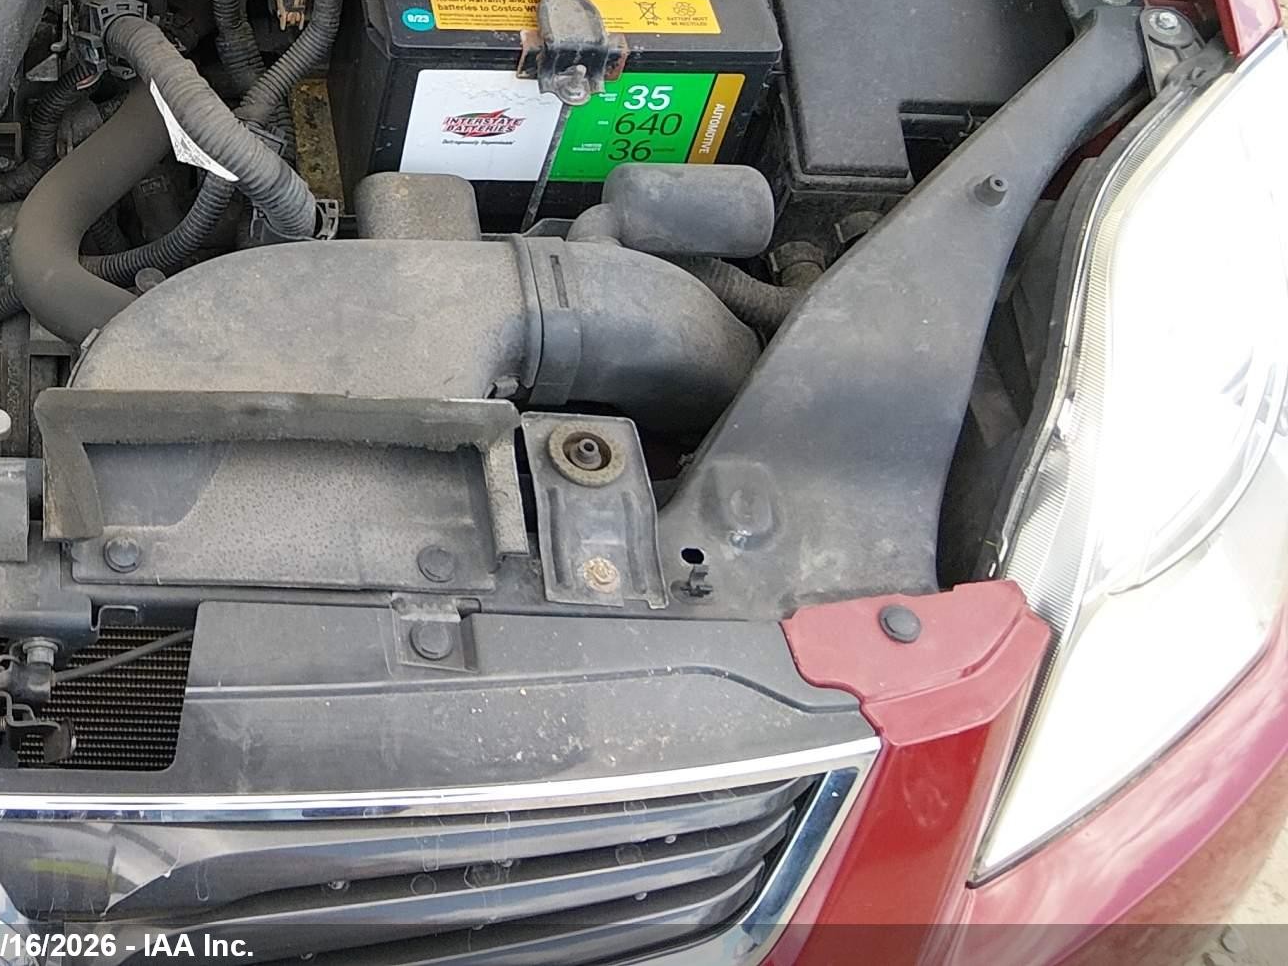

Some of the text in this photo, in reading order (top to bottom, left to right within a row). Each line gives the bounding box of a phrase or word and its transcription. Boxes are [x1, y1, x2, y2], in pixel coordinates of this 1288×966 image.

[491, 4, 523, 12] Costco
[623, 84, 673, 111] 35
[444, 116, 523, 126] INTERSTATE
[614, 112, 683, 136] 640
[699, 103, 726, 154] AUTOMOTIVE
[608, 138, 652, 162] 36
